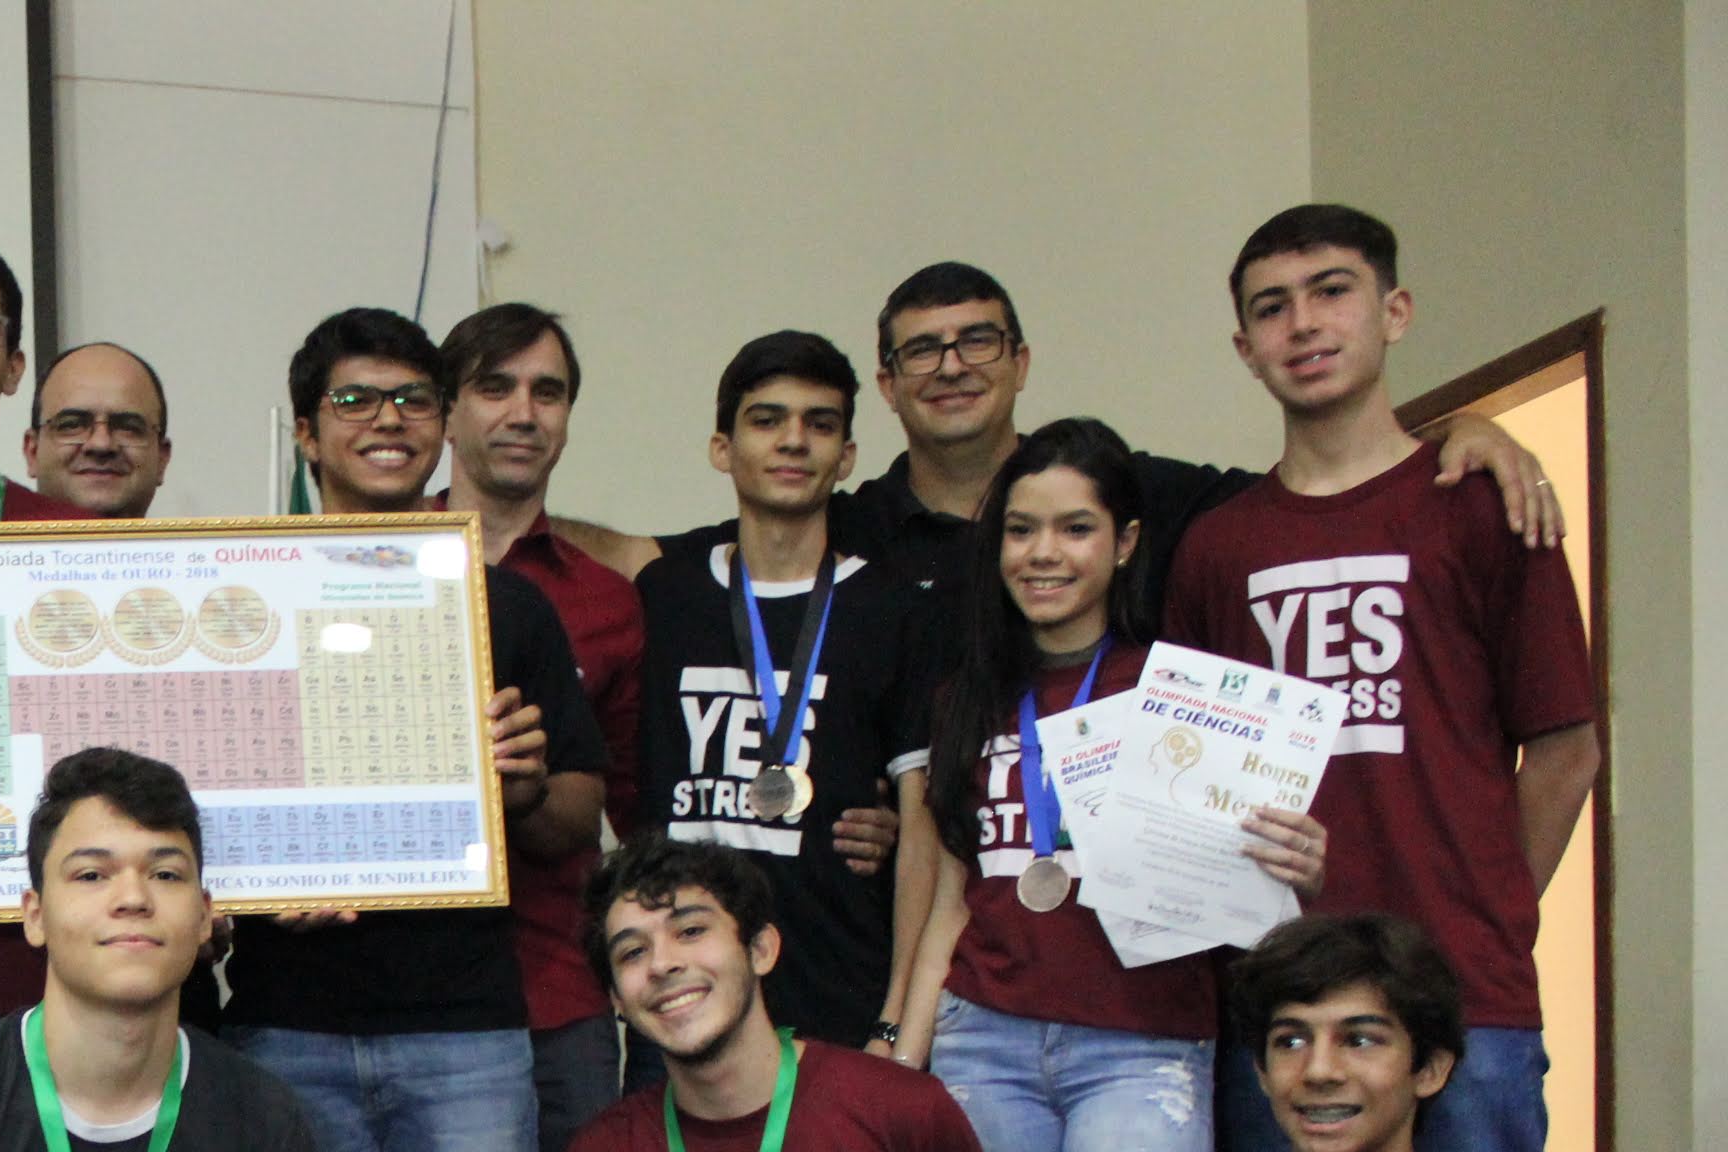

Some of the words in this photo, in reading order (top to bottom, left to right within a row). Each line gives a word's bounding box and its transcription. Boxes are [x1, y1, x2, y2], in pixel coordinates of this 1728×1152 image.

[52, 549, 175, 566] Tocantinense
[187, 551, 206, 564] de
[215, 544, 302, 564] QUÍMICA
[28, 569, 97, 583] Medalhas
[101, 569, 118, 581] de
[185, 567, 219, 580] 2018
[1249, 586, 1404, 678] YES
[1141, 698, 1170, 717] DE
[1172, 705, 1266, 743] CIÊNCIAS
[1146, 685, 1209, 711] OLIMPÍADA
[1210, 703, 1271, 727] NACIONAL
[680, 696, 816, 780] YE
[1075, 738, 1121, 760] OLIMPÍ
[1060, 749, 1119, 777] BRASILEI
[1241, 750, 1311, 790] Honra
[672, 779, 800, 824] STRE
[1274, 788, 1304, 809] ao
[266, 873, 327, 888] SONHO
[331, 873, 354, 887] DE
